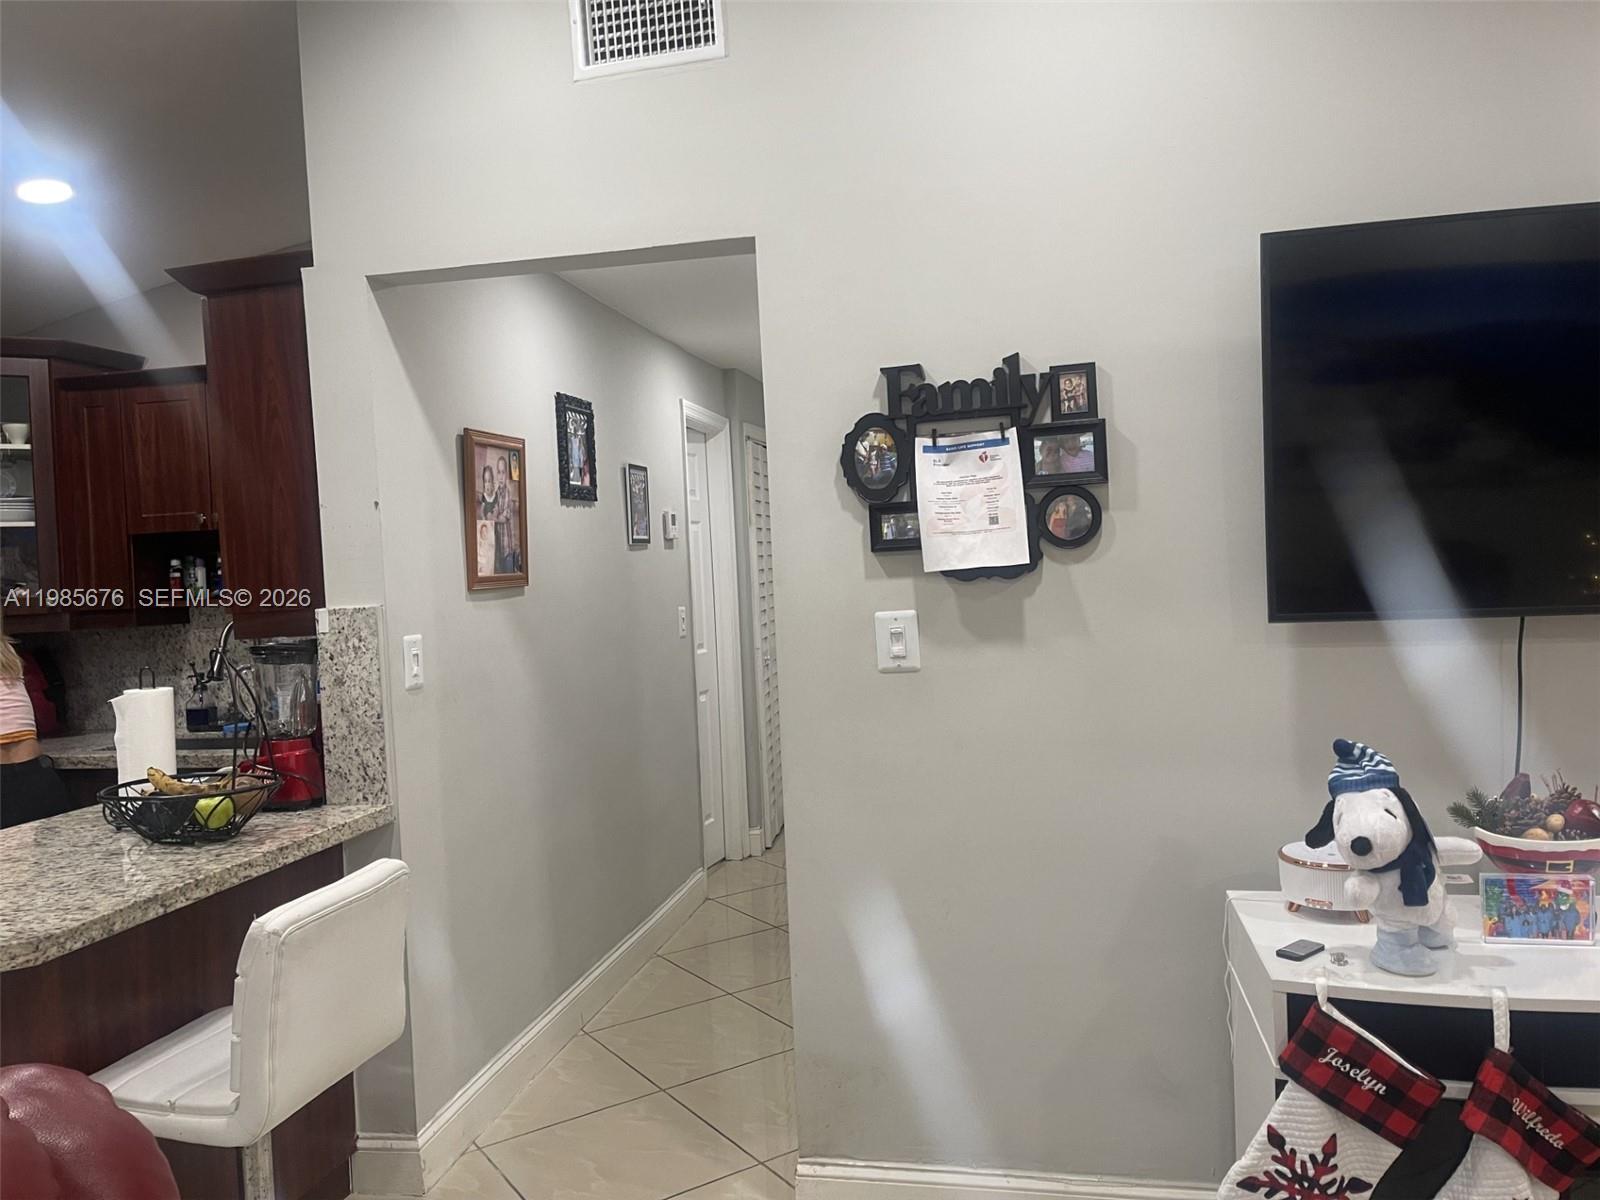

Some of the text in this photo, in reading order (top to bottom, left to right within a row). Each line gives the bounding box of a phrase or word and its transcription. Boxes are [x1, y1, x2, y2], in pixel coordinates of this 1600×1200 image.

[880, 352, 1051, 428] Family
[1318, 1047, 1388, 1096] Joselyn
[1512, 1097, 1565, 1150] Wilfredo
